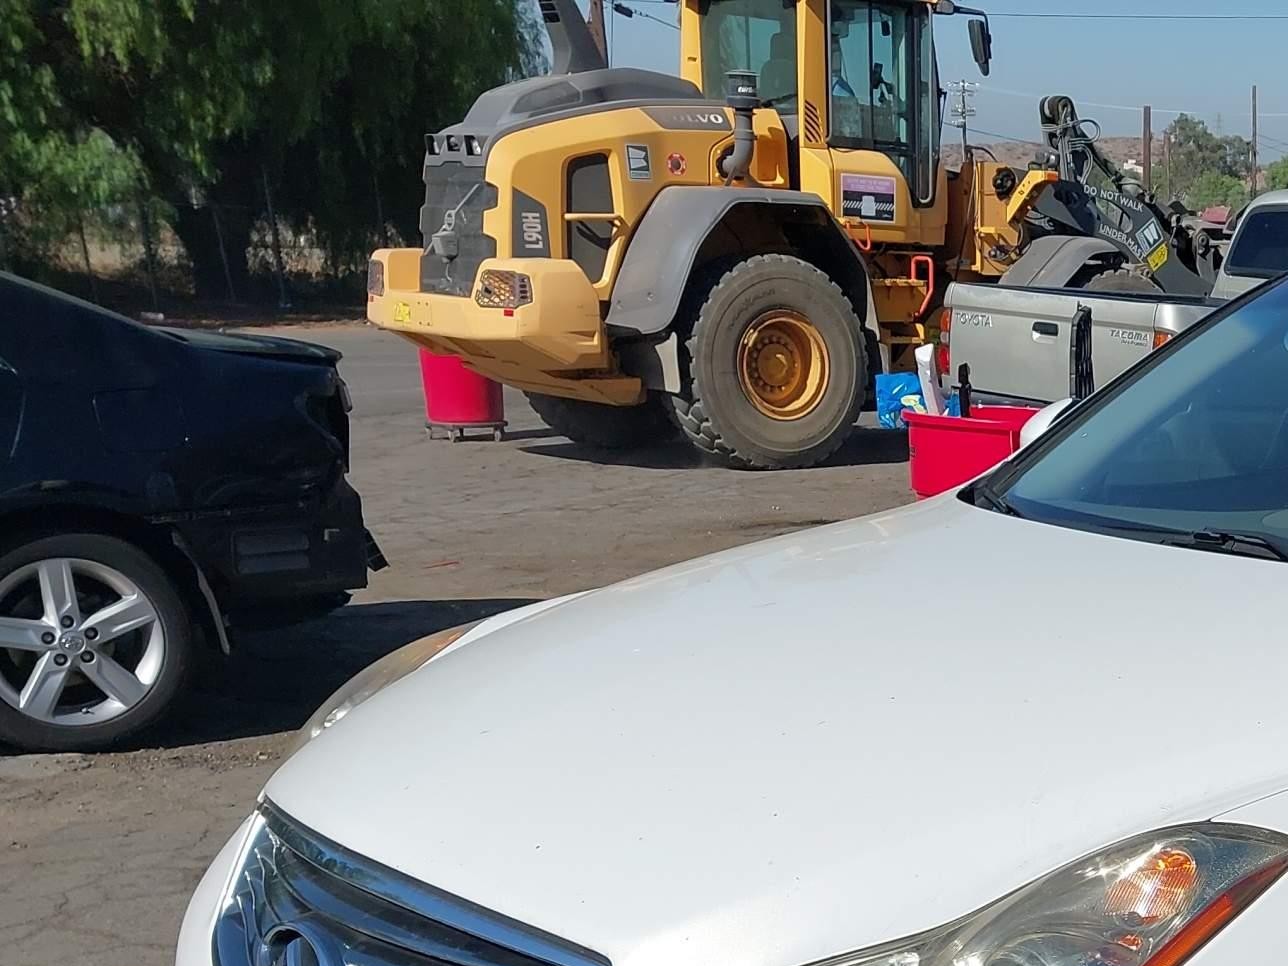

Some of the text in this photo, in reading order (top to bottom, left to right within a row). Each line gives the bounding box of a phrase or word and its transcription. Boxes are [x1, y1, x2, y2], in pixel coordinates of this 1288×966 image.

[1083, 184, 1145, 213] DO NOT WALK
[520, 212, 544, 249] L90H
[1100, 223, 1147, 261] UNDER MAST
[955, 312, 993, 328] TOYOTA
[1110, 329, 1150, 341] TACOMA
